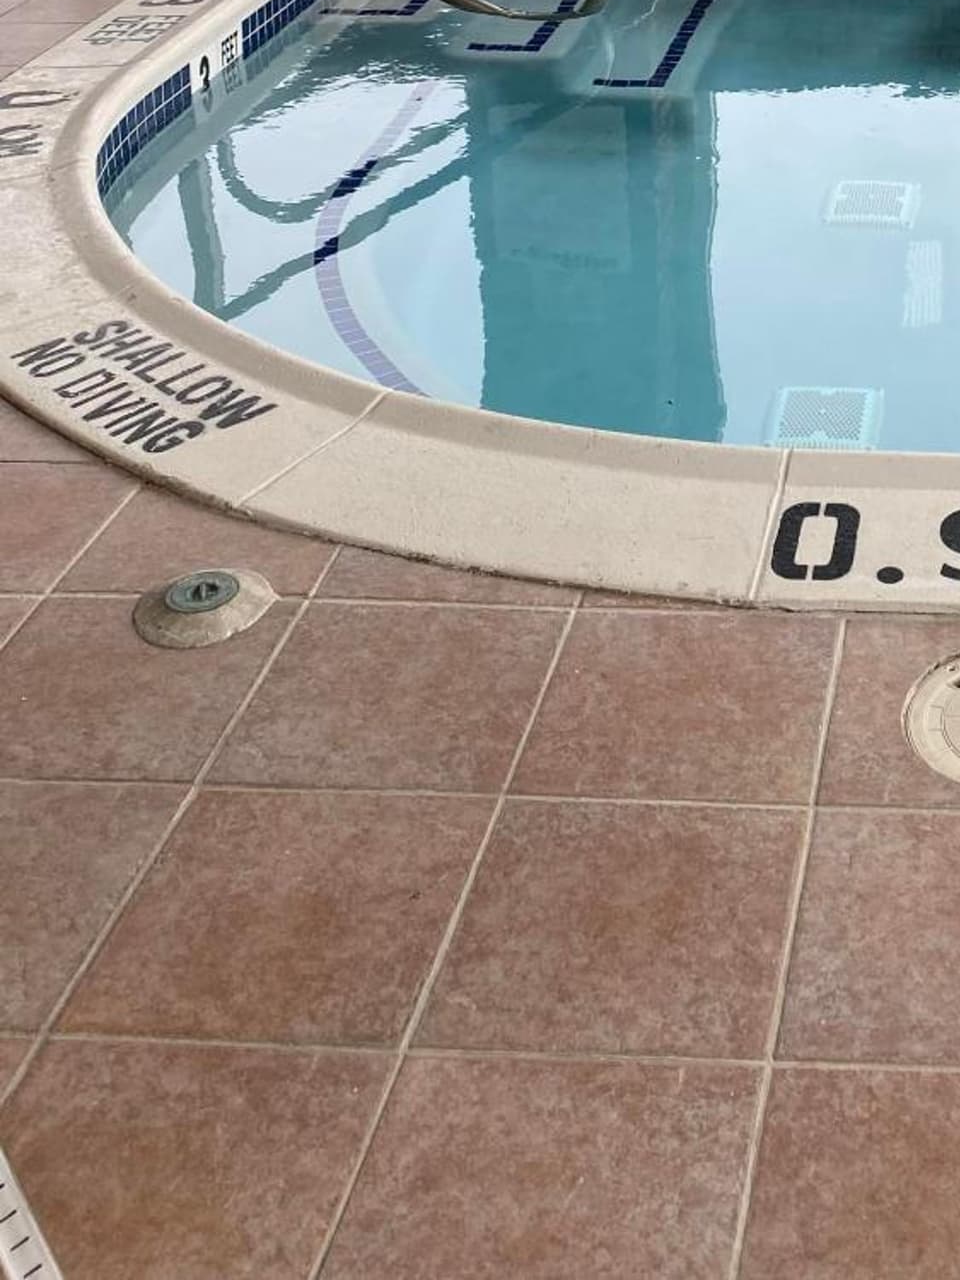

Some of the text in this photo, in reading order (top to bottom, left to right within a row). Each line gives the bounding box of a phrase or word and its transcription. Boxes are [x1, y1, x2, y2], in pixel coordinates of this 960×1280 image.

[221, 31, 238, 66] FEET
[10, 337, 206, 453] NO DIVING
[73, 320, 279, 429] SHALLOW
